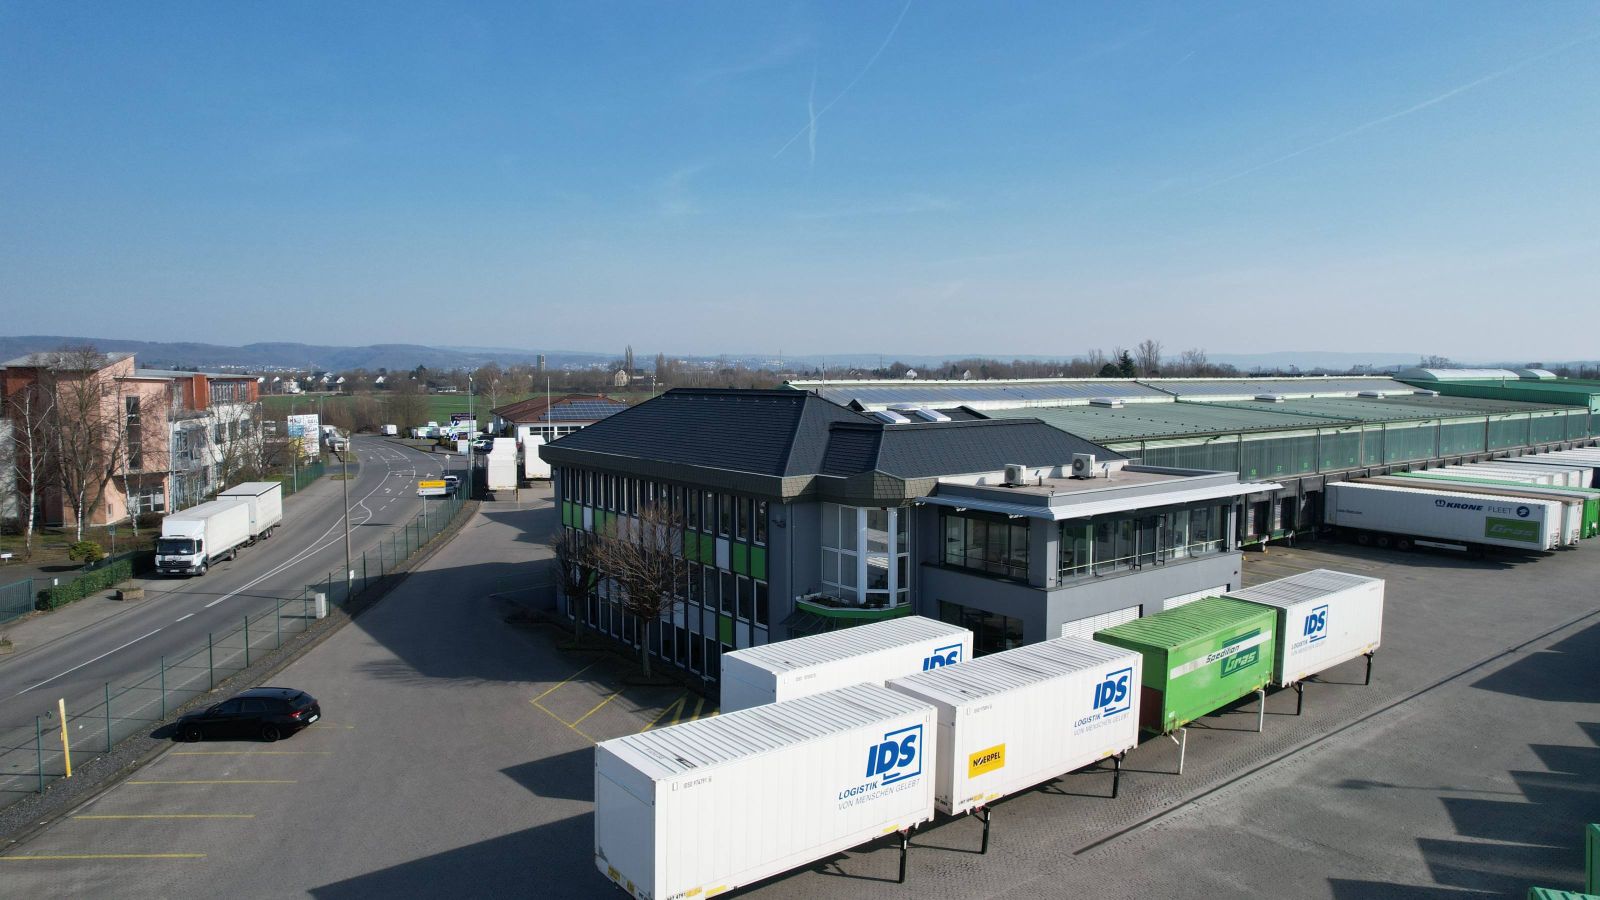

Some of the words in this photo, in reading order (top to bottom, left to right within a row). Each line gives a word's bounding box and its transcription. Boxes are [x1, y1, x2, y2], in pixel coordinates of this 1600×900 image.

[1446, 502, 1484, 512] KRONE
[1488, 506, 1512, 514] FLEET
[1304, 610, 1326, 636] IDS
[1225, 651, 1257, 673] Gras
[1093, 675, 1128, 710] IDS
[1074, 713, 1101, 728] LOGISTIK
[866, 734, 917, 778] IDS
[838, 781, 878, 800] LOGISTIK
[838, 799, 854, 811] VON
[855, 787, 895, 805] MENSCHEN
[896, 778, 920, 792] GELEBT
